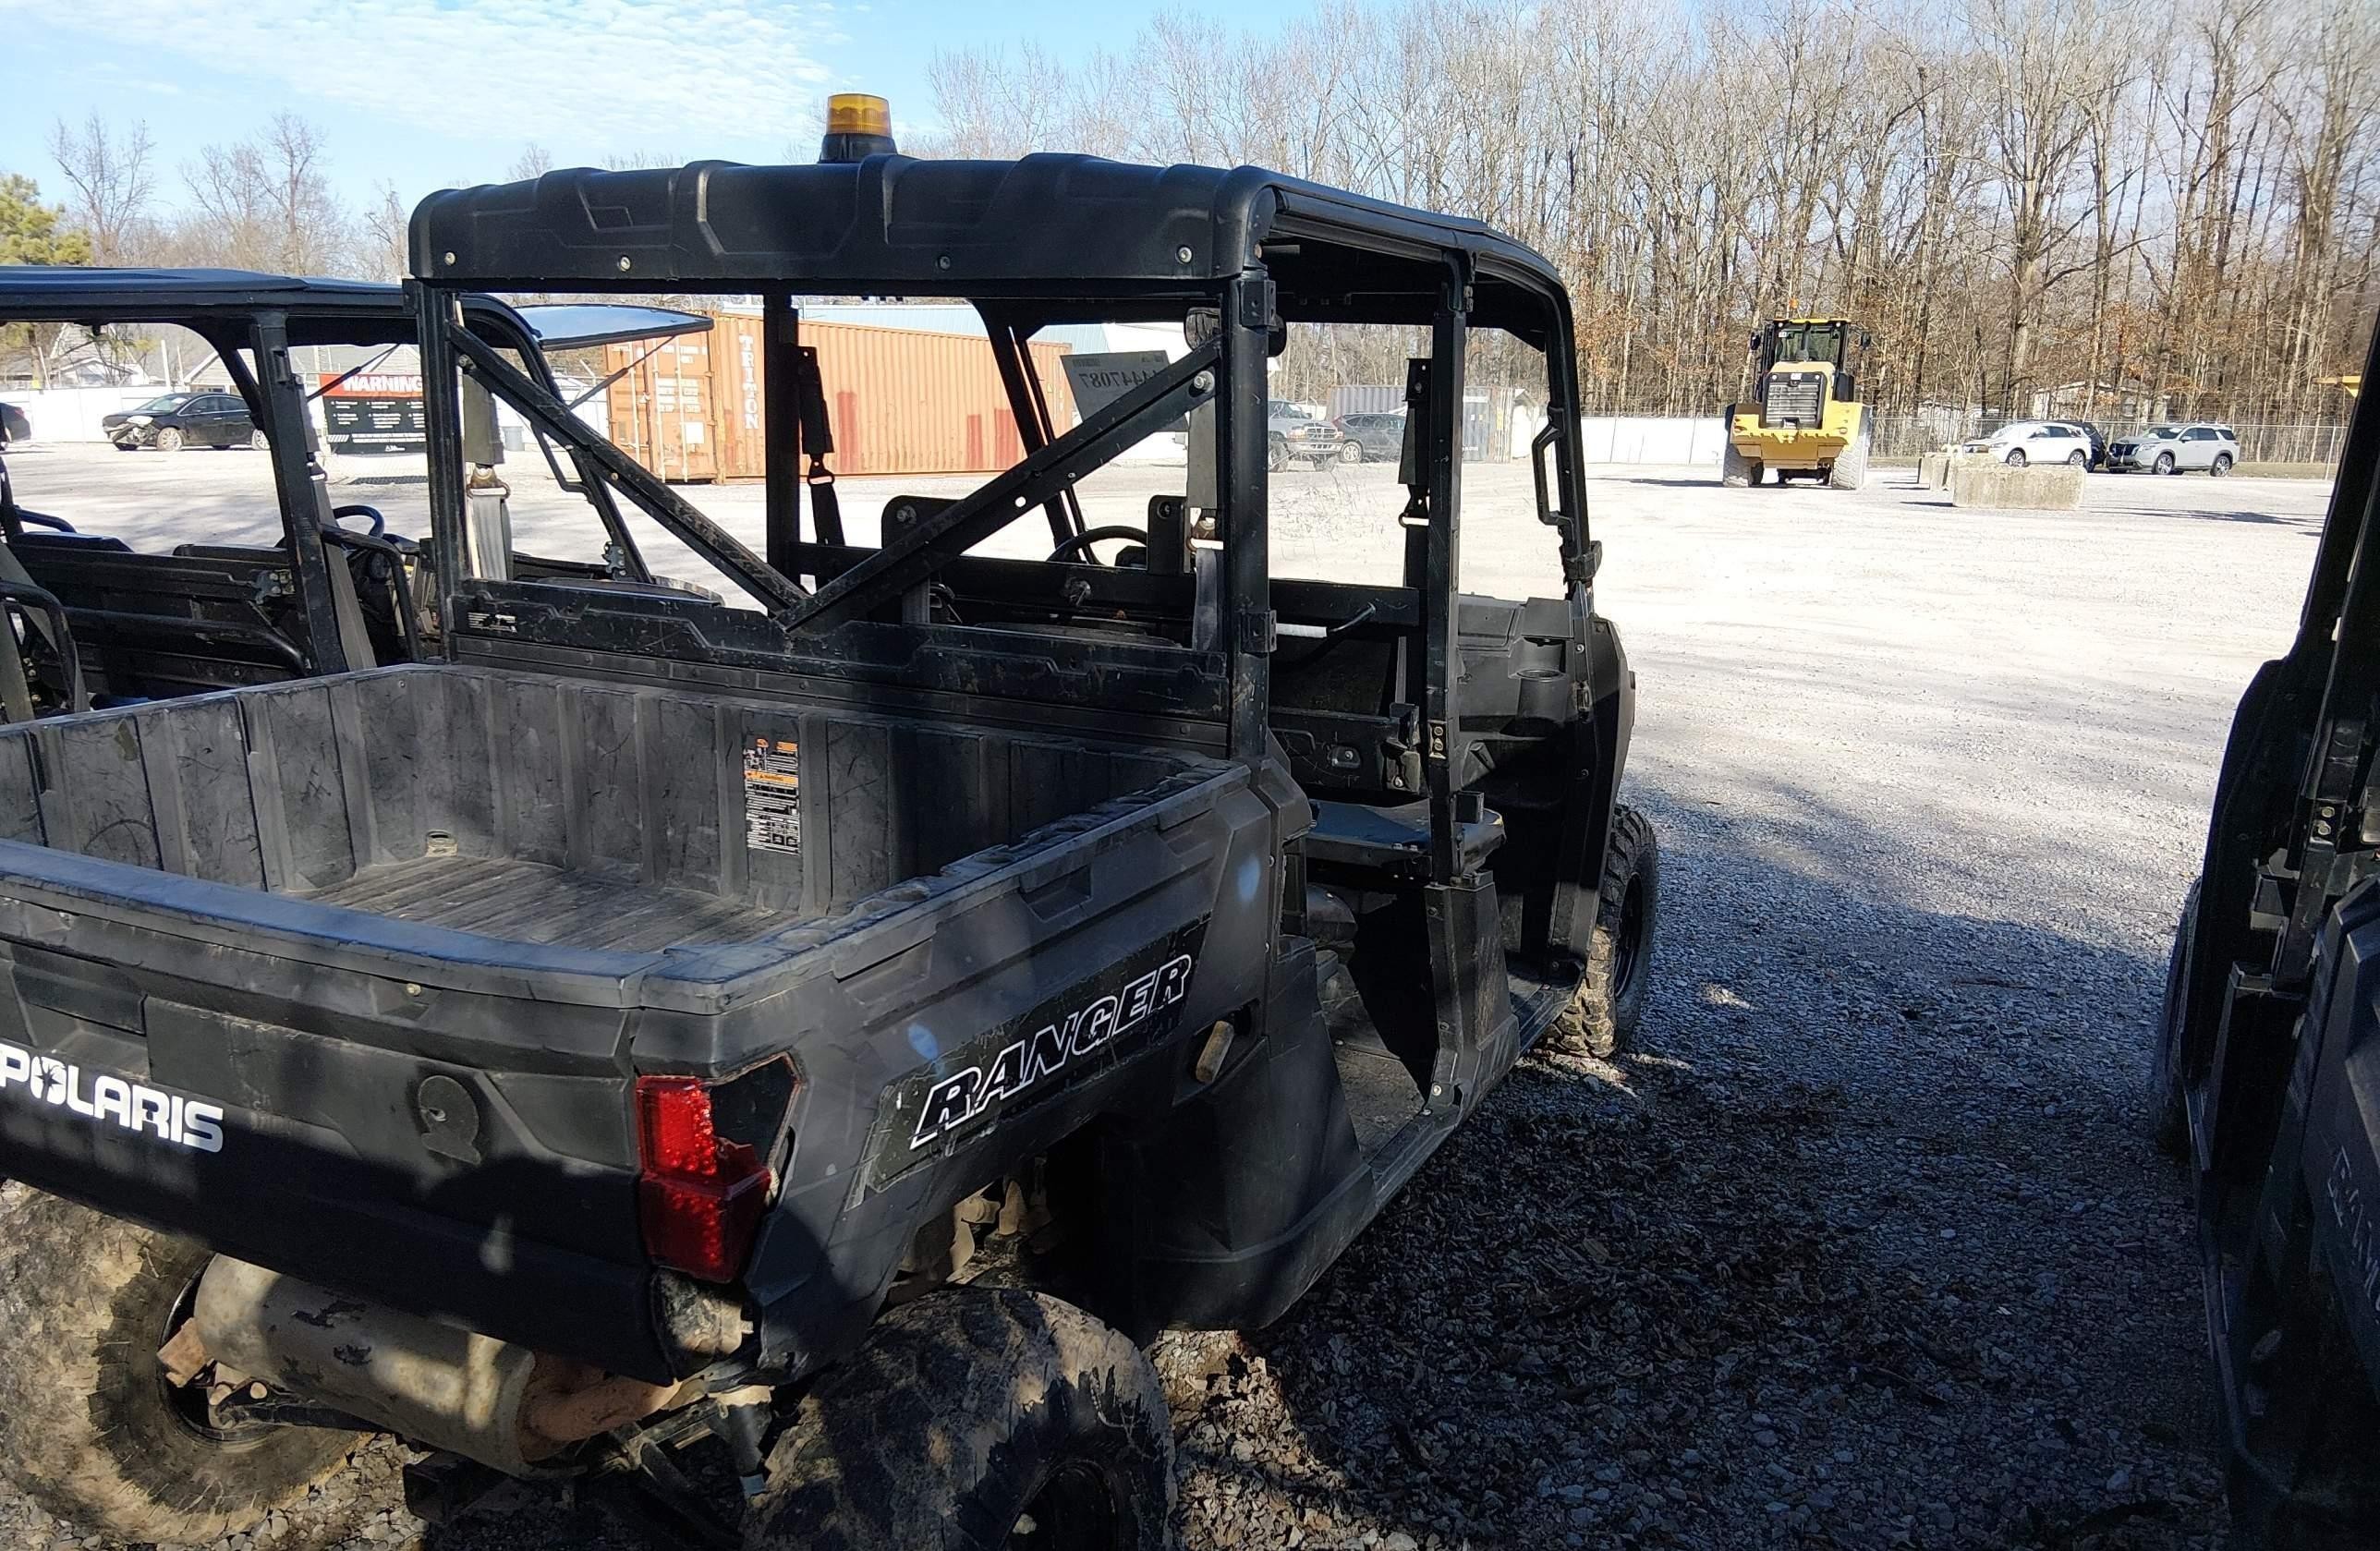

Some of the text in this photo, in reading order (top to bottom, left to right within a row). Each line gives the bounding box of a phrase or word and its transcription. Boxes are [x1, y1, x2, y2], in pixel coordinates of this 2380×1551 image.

[343, 375, 423, 393] WARNING
[739, 335, 759, 430] TRITON
[0, 1043, 224, 1153] POLARIS
[909, 953, 1192, 1151] RANGER
